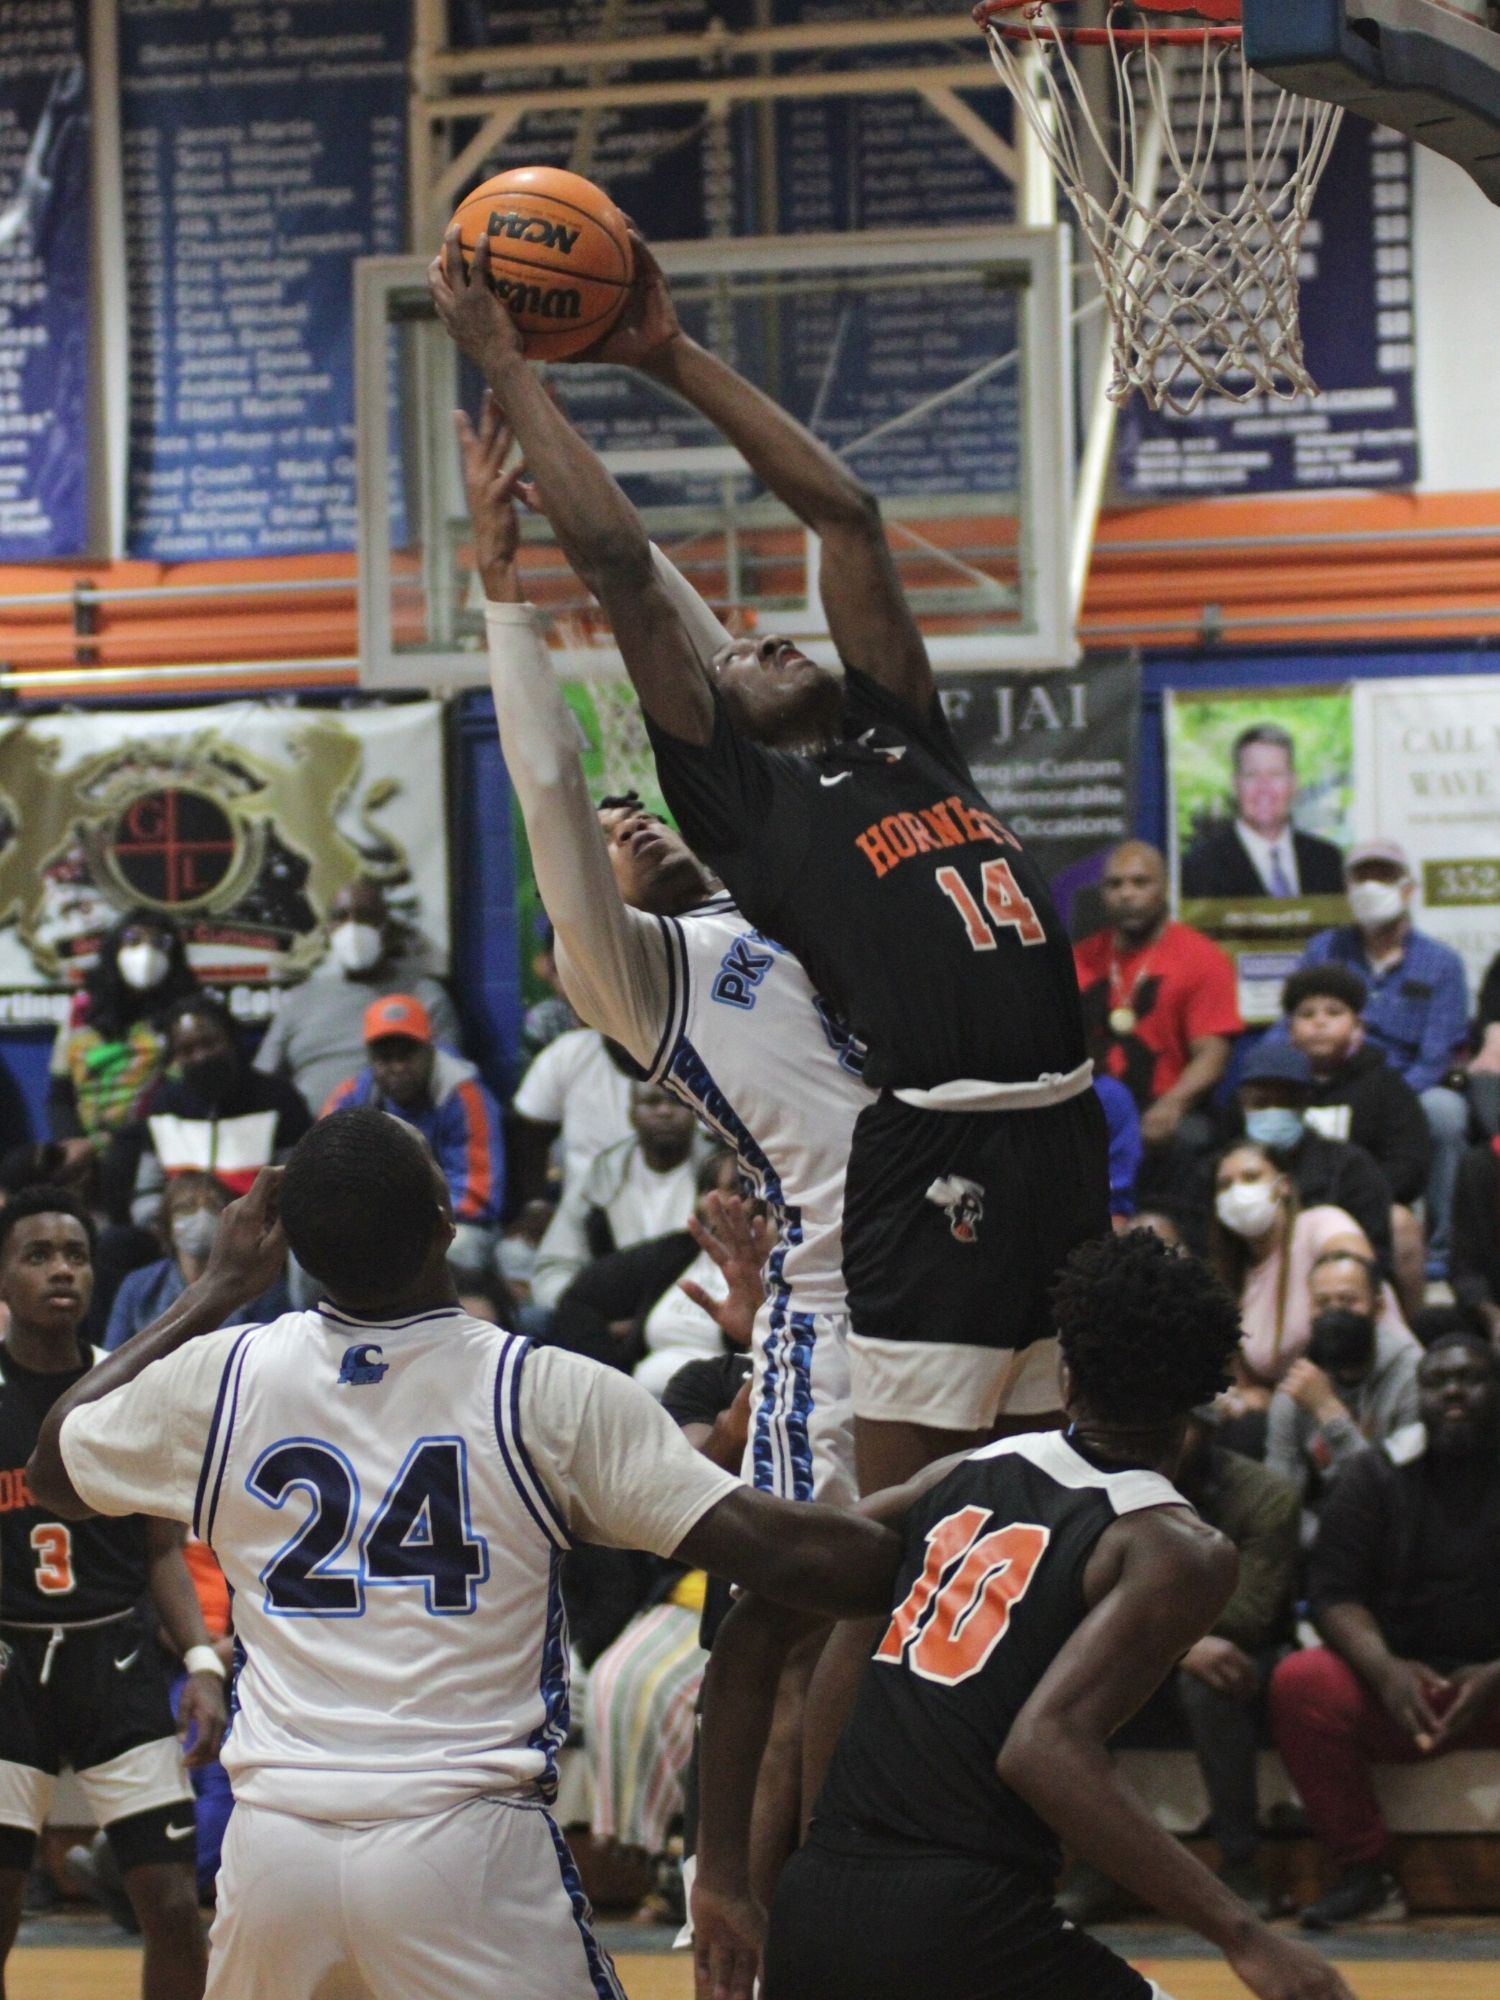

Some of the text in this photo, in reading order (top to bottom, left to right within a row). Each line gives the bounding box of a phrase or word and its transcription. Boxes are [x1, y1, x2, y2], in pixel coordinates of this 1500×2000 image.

[487, 211, 581, 255] NCAA
[994, 683, 1088, 744] JAI
[1038, 759, 1121, 779] Custom
[1009, 817, 1123, 837] Occasions
[935, 857, 1047, 951] 14
[30, 1522, 76, 1594] 3
[245, 1435, 490, 1618] 24
[872, 1504, 1051, 1687] 10
